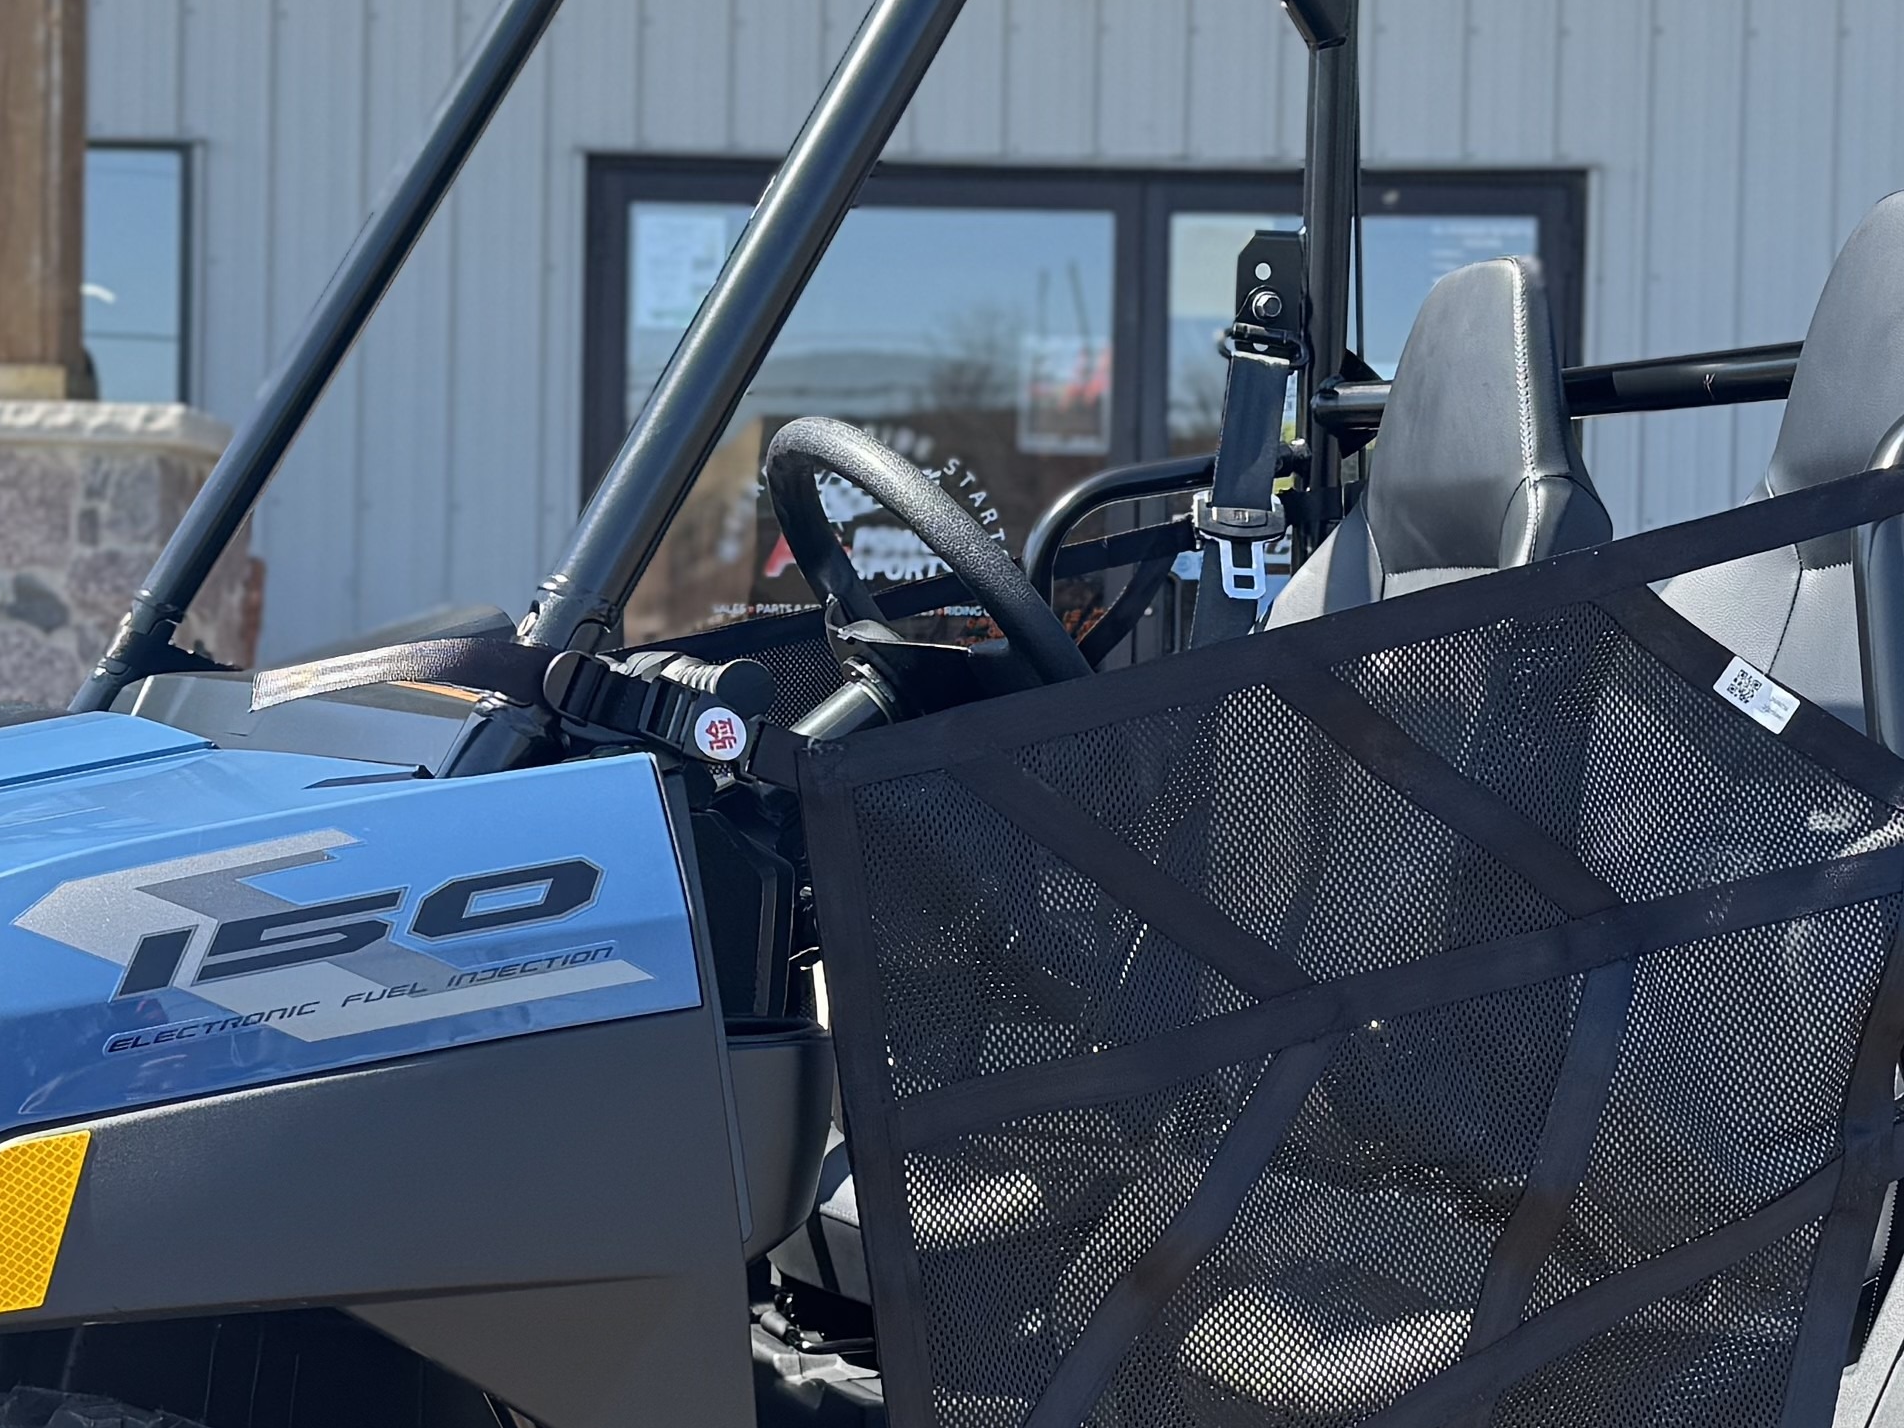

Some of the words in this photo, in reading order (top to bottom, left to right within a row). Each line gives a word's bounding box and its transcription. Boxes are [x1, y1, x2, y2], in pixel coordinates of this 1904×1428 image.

[943, 458, 1009, 556] START
[705, 717, 738, 751] 验
[114, 856, 603, 1000] 150
[106, 1000, 321, 1054] ELECTRONIC
[342, 981, 428, 1008] FUEL
[446, 946, 615, 989] INJECTION
